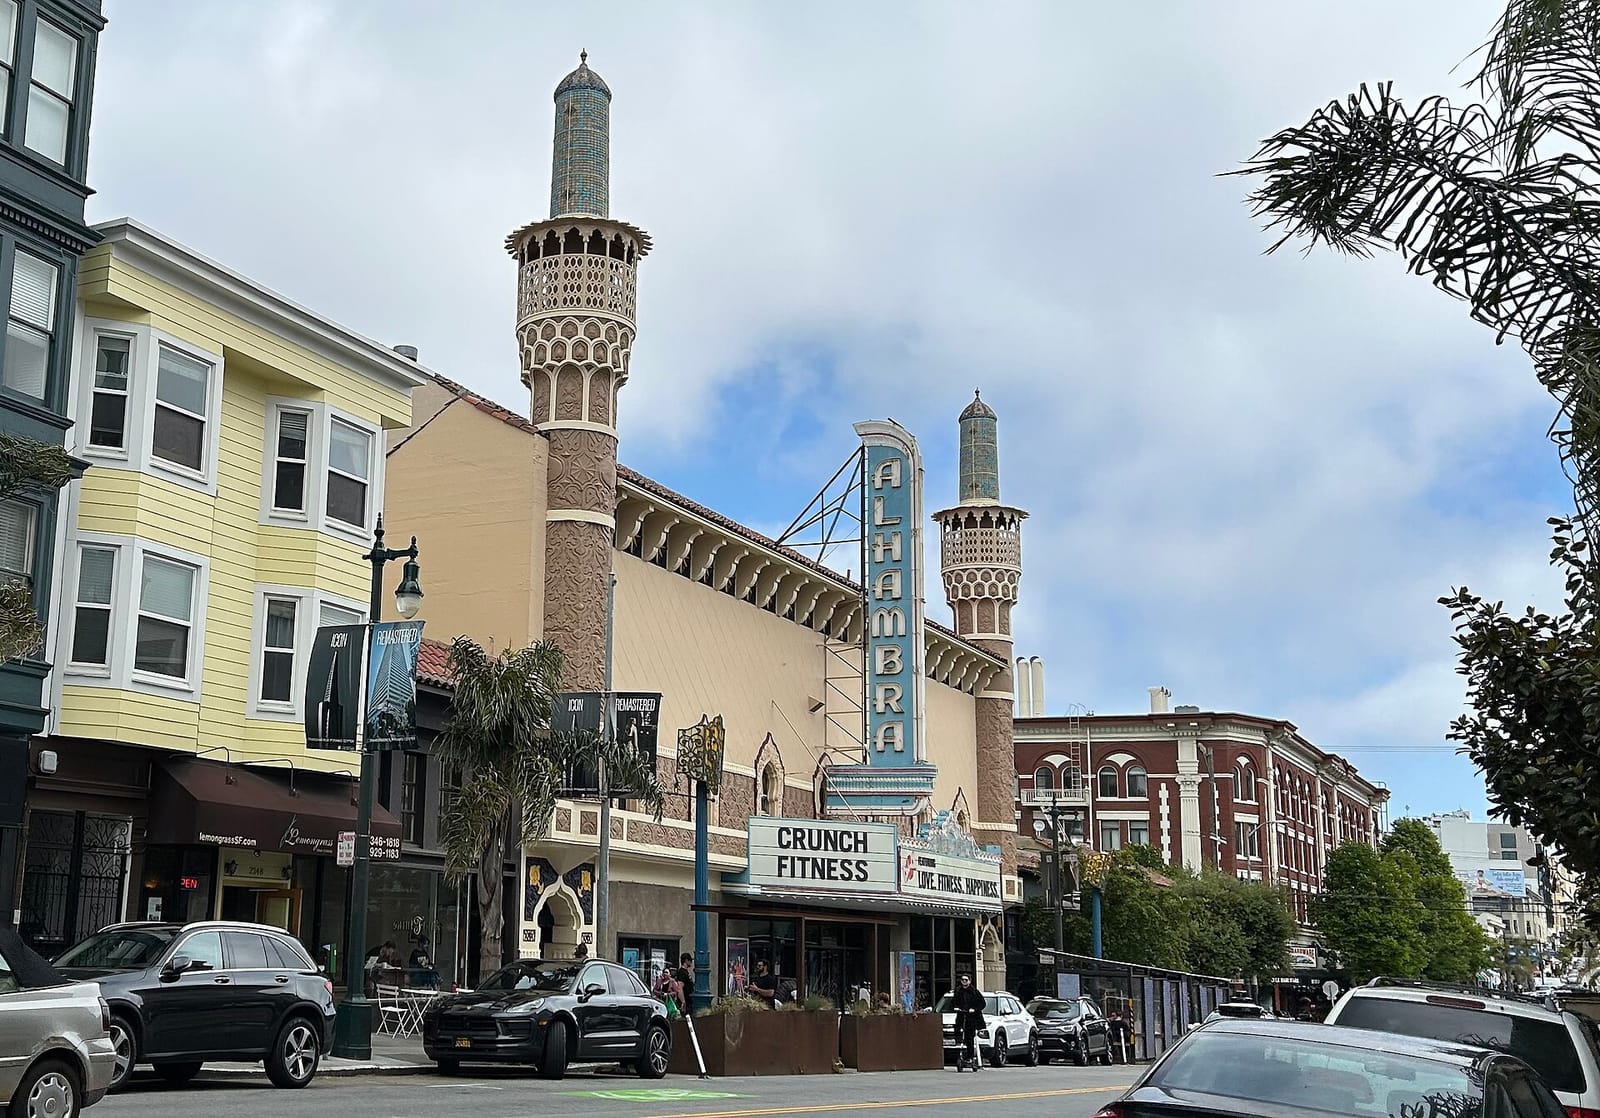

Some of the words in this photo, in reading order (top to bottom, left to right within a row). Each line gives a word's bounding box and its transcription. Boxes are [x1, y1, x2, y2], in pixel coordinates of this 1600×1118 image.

[871, 457, 906, 753] ALHAMBRA
[330, 633, 348, 648] ICON
[376, 628, 418, 646] REMASTERED
[568, 698, 584, 712] ICON
[615, 698, 656, 712] REMASTERED
[285, 827, 334, 852] Lemongrass
[777, 826, 868, 854] CRUNCH
[777, 855, 869, 882] FITNESS
[180, 878, 198, 889] PEN
[918, 870, 937, 888] LOVE.
[938, 873, 965, 894] FITNESS.
[965, 877, 1000, 898] HAPPINESS.
